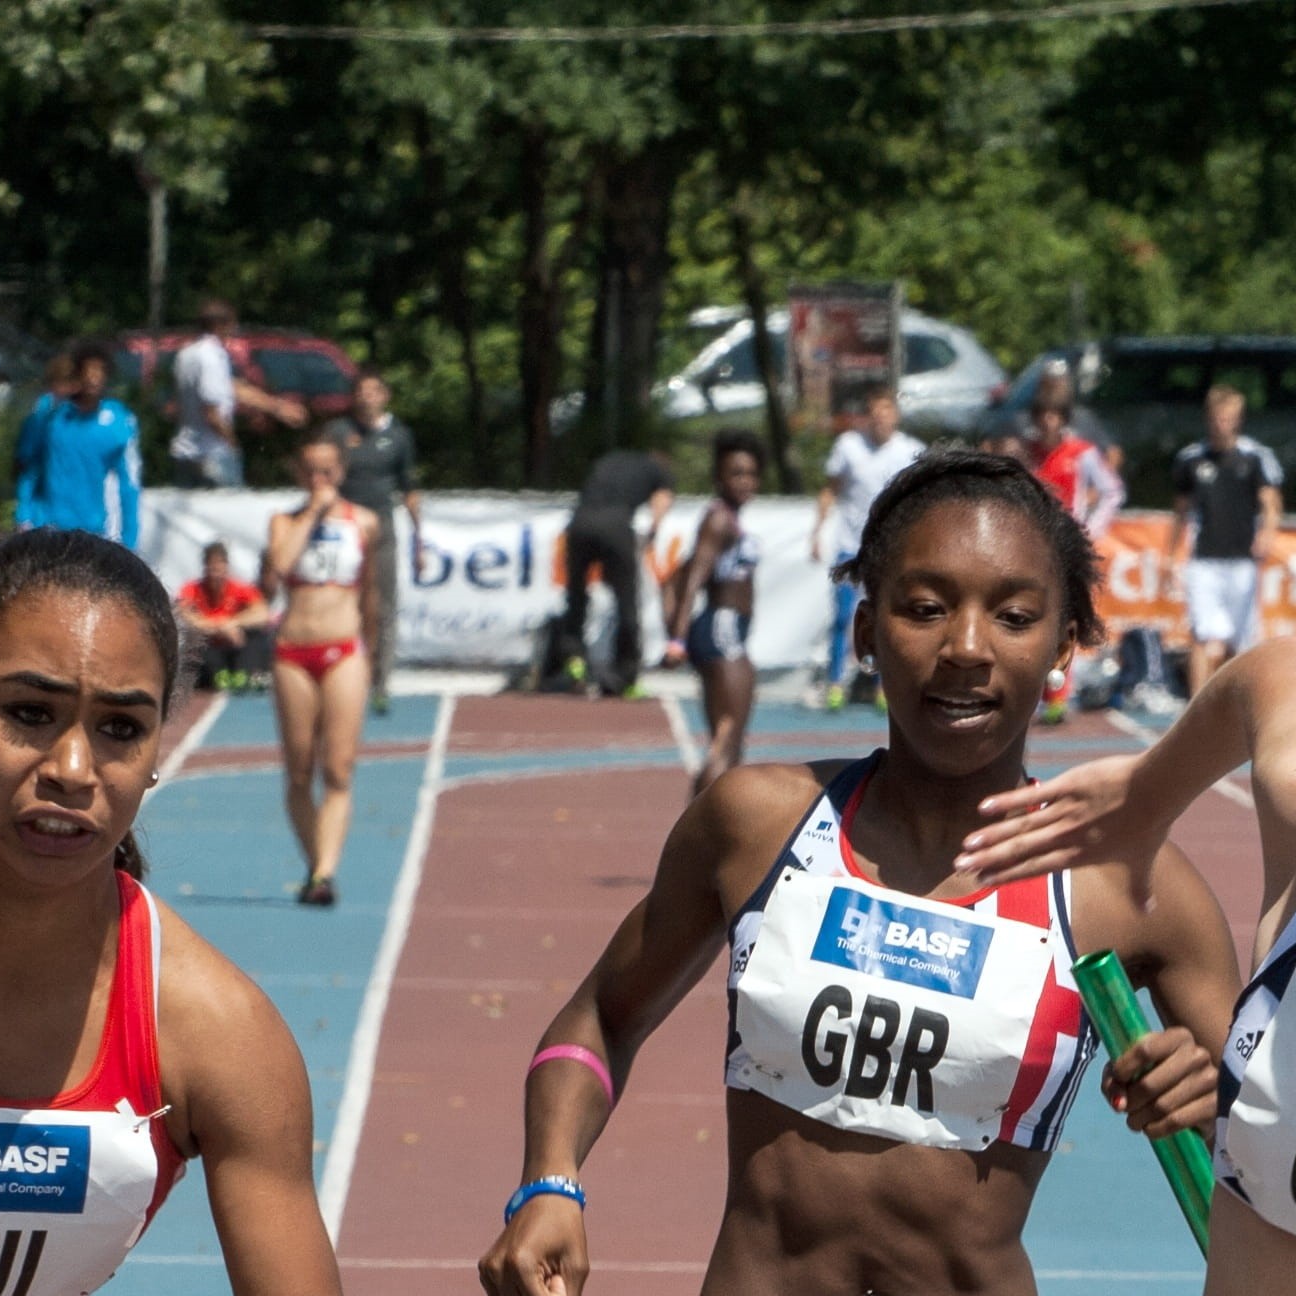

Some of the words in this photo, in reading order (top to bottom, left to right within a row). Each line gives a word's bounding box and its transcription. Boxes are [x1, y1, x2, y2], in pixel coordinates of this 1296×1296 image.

[803, 830, 835, 844] AVIVA
[836, 936, 858, 951] The
[858, 943, 908, 966] Chemical
[908, 957, 962, 981] Company
[884, 921, 971, 960] BASF
[801, 984, 950, 1114] GBR
[8, 1181, 65, 1197] Company
